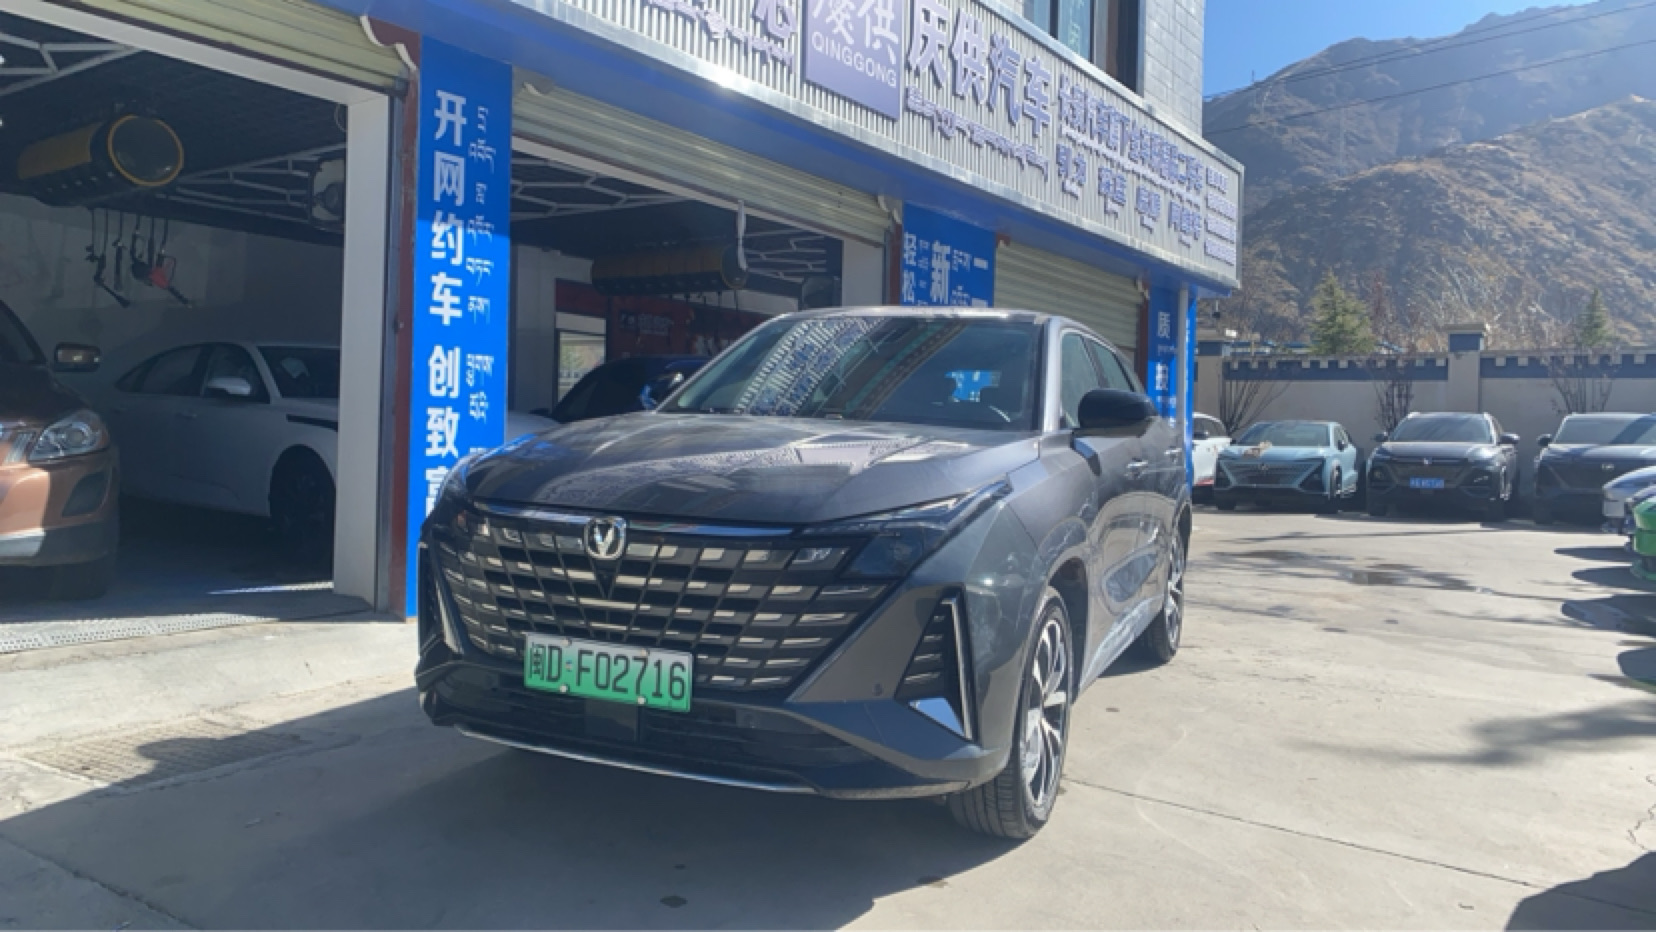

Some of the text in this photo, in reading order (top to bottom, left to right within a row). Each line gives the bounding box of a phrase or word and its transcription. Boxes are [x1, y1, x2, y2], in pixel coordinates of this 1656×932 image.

[811, 31, 897, 89] QINGGONG
[908, 0, 1051, 137] 庆供汽车
[429, 89, 467, 326] 开网约车
